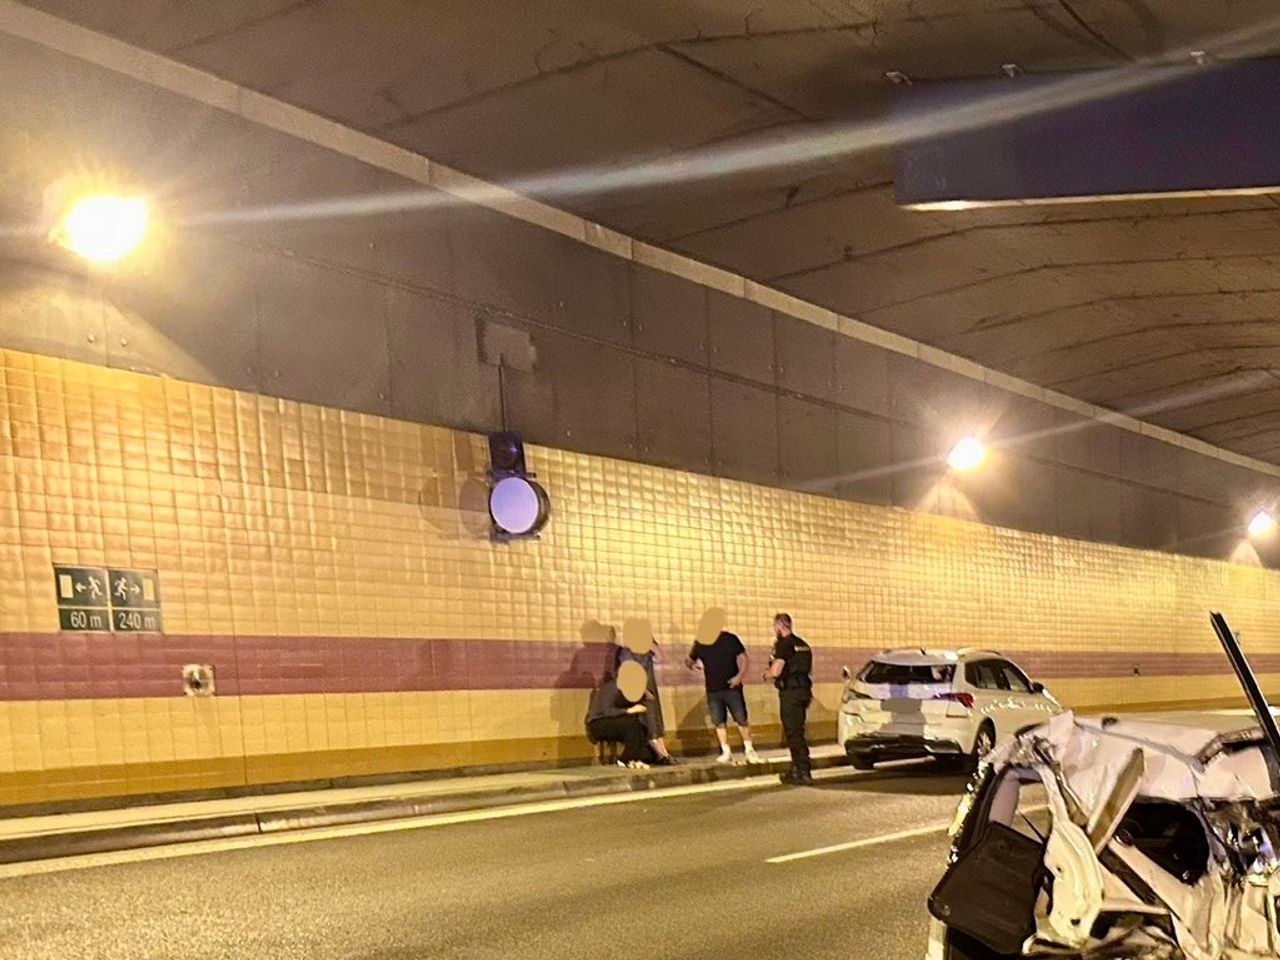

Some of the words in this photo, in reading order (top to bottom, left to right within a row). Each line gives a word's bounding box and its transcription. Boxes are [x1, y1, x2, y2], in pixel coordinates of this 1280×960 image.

[70, 611, 87, 628] 60
[90, 615, 101, 628] m
[119, 612, 141, 629] 240
[144, 617, 156, 629] m
